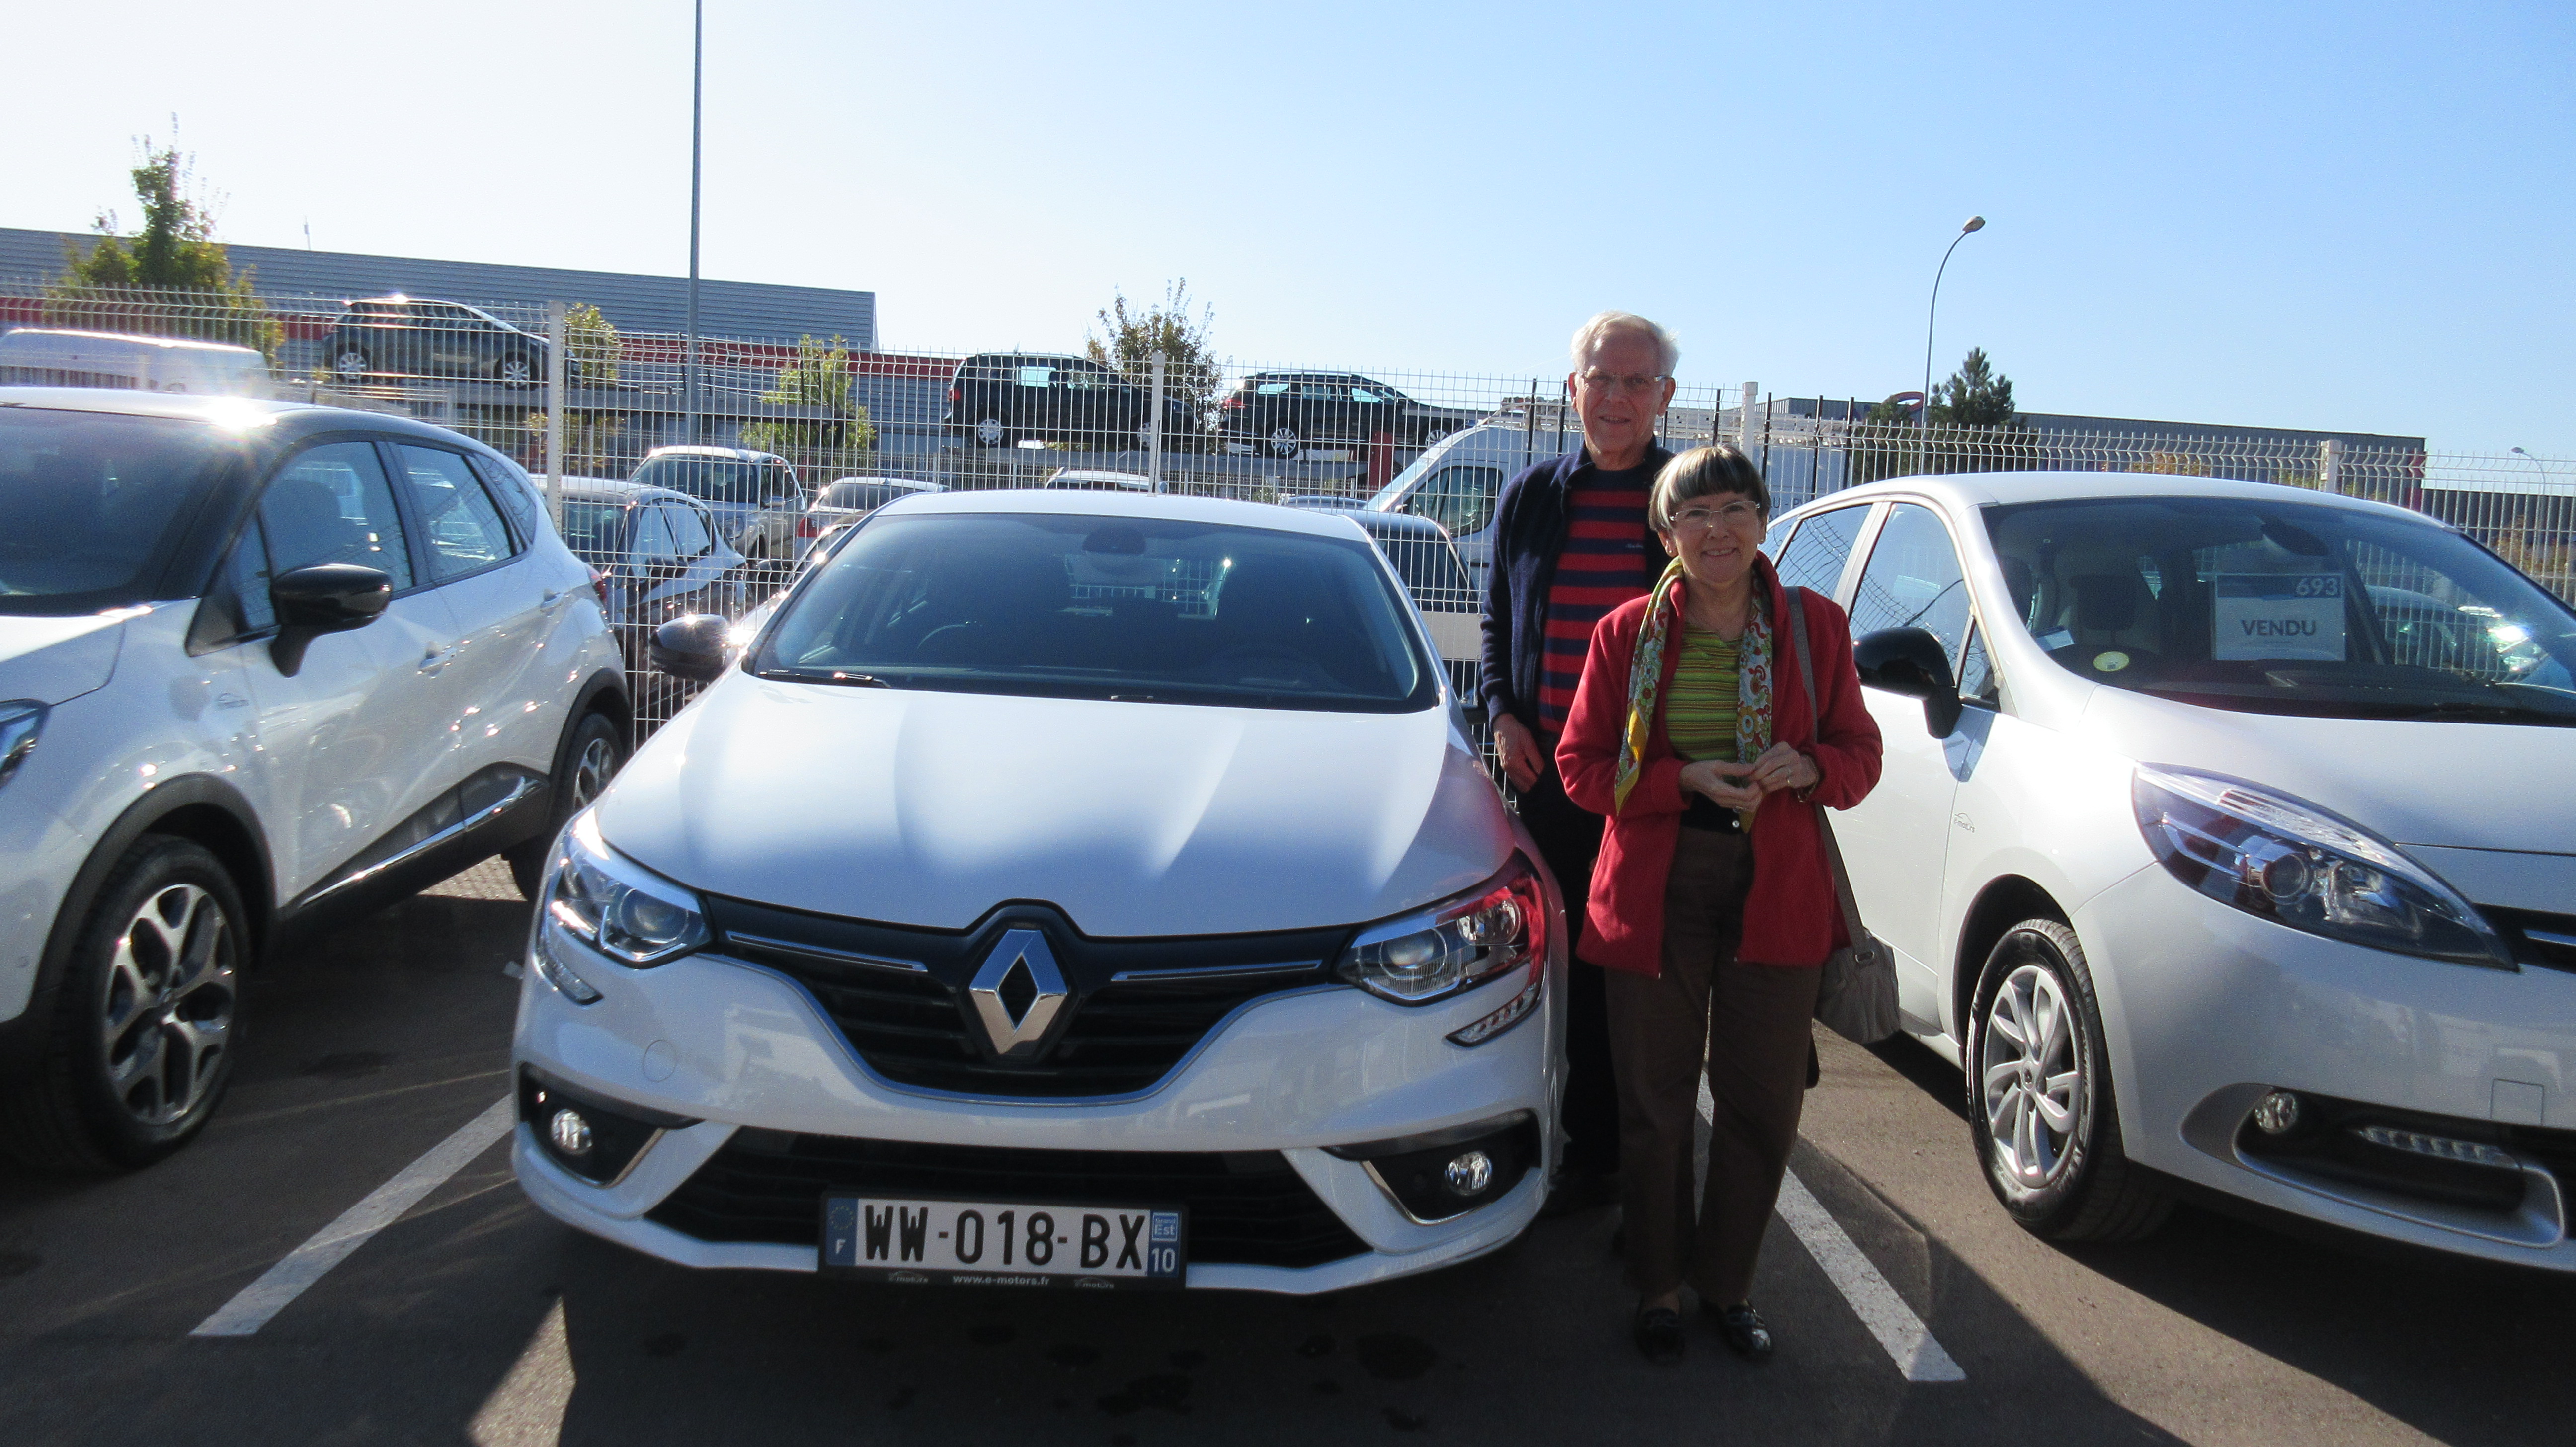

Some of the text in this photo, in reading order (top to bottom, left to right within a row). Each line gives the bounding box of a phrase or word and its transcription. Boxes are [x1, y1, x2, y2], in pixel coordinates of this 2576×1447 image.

[2295, 578, 2338, 596] 693
[2242, 620, 2316, 636] VENDU
[1154, 1224, 1176, 1236] Est
[835, 1239, 846, 1254] F
[1151, 1248, 1176, 1272] 10
[953, 1275, 1050, 1286] www.e-motors.fr
